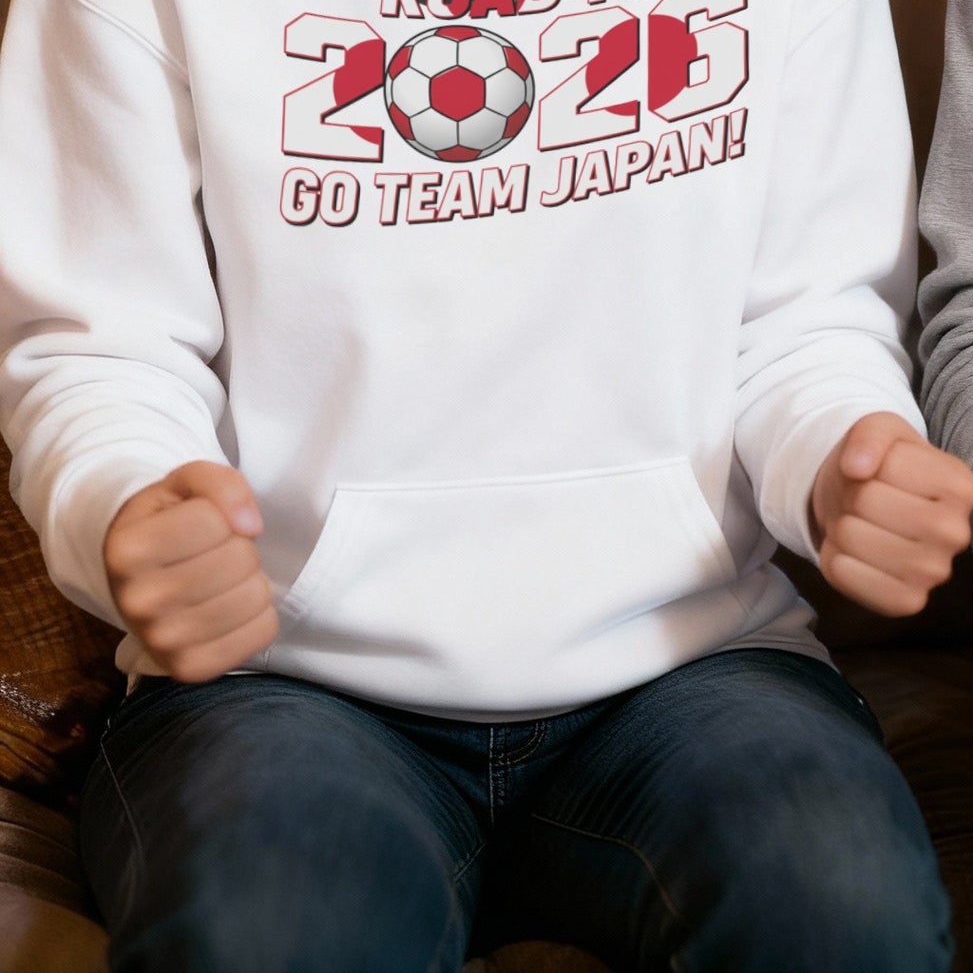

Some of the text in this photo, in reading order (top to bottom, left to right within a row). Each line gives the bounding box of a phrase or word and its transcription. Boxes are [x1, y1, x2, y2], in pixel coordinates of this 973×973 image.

[280, 107, 748, 225] GO TEAM JAPAN!
